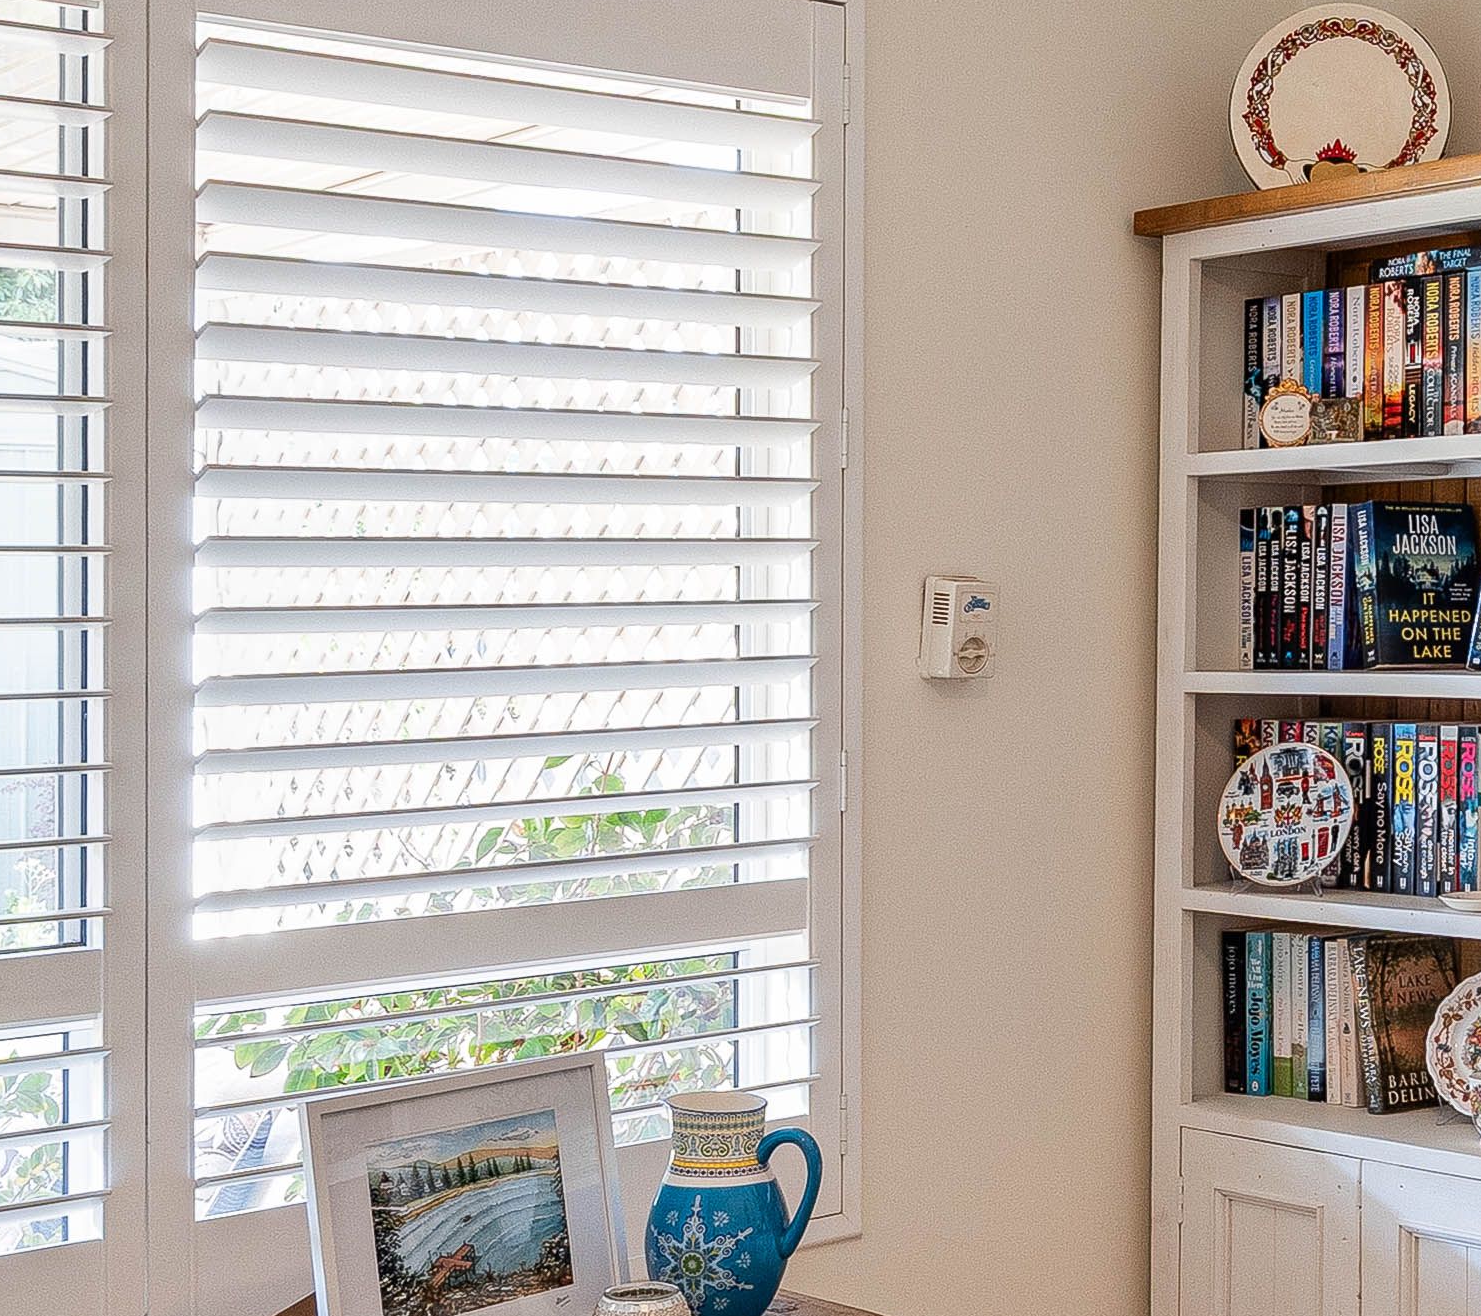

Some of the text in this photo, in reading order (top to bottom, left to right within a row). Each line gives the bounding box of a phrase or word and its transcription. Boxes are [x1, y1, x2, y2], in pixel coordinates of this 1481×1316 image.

[1439, 248, 1471, 260] THE FINAL
[1379, 264, 1415, 278] ROBERTS
[1442, 258, 1468, 269] TARGET
[1408, 514, 1439, 534] LISA
[1392, 535, 1457, 556] JACKSON
[1330, 516, 1345, 607] LISA JACKSON
[1423, 592, 1435, 605] IT
[1389, 610, 1471, 623] HAPPENED
[1401, 627, 1461, 640] ON THE
[1413, 645, 1452, 658] LAKE
[1373, 737, 1385, 774] ROSE
[1395, 740, 1414, 805] ROSE
[1375, 782, 1386, 865] Say no More
[1270, 826, 1307, 837] LONDON
[1399, 974, 1431, 989] LAKE
[1397, 990, 1436, 1004] NEWS
[1248, 992, 1264, 1076] Jojo Moyes
[1388, 1072, 1428, 1088] BARB
[1388, 1088, 1435, 1104] DELIN
